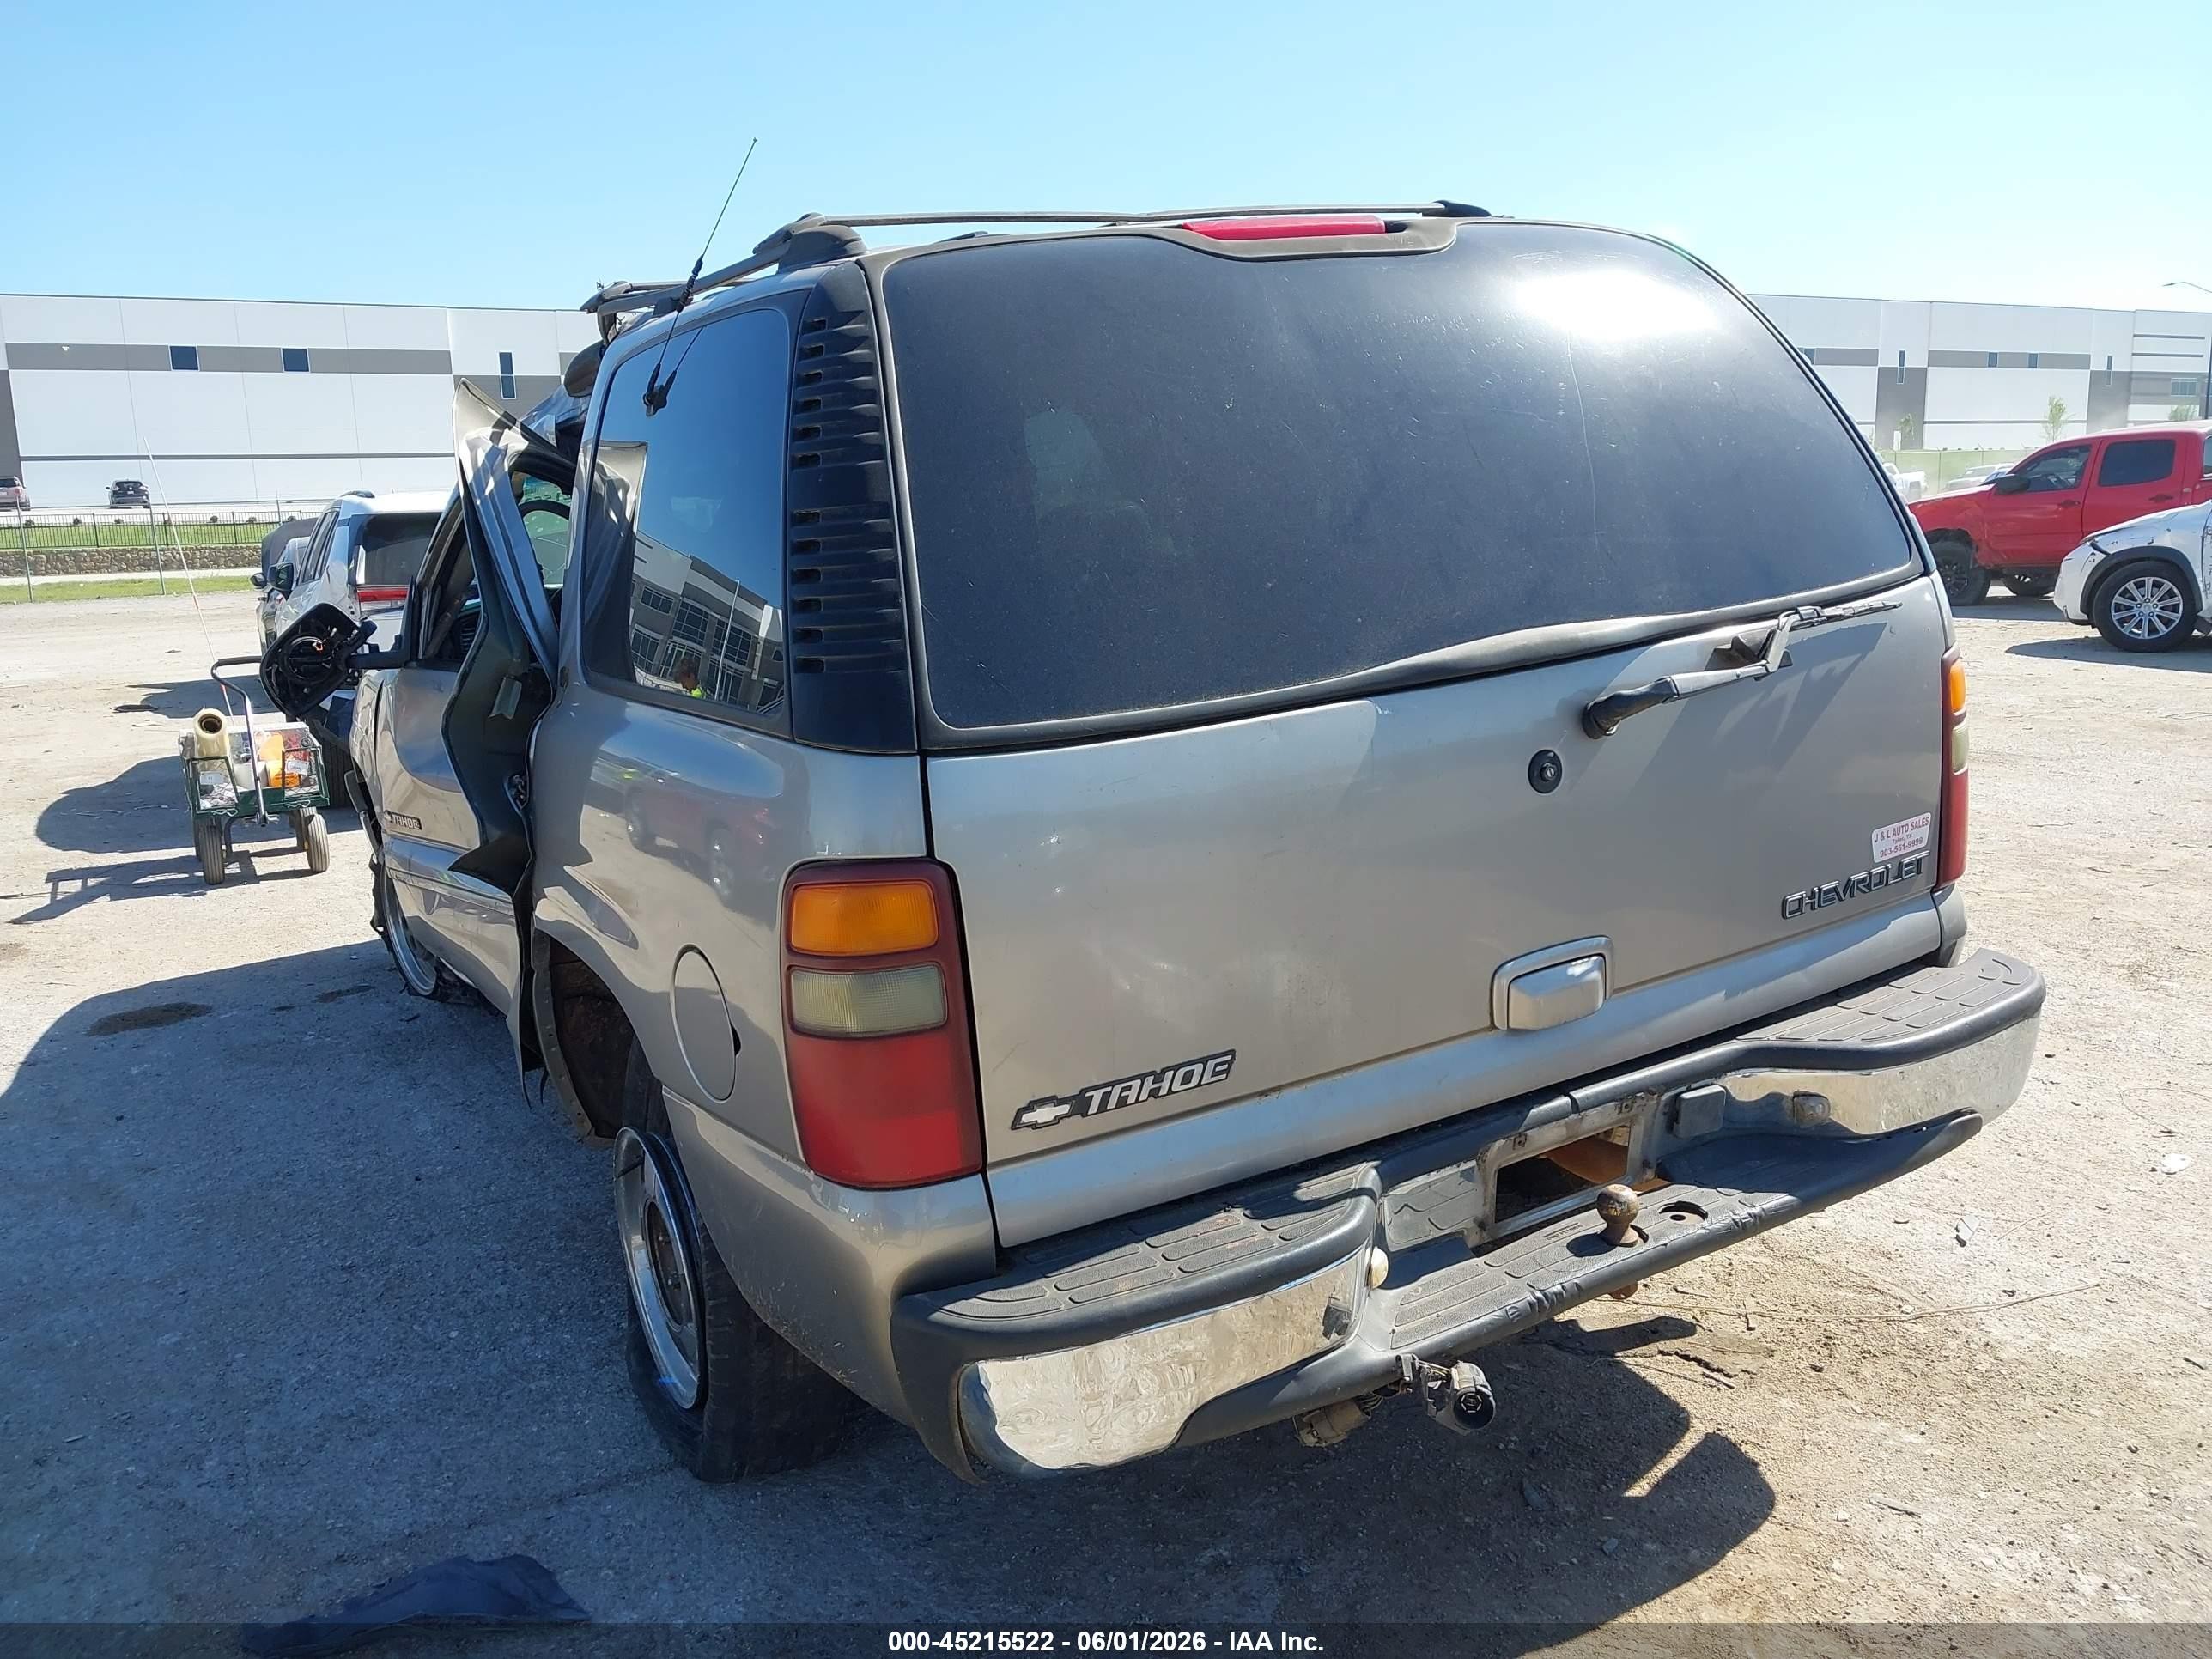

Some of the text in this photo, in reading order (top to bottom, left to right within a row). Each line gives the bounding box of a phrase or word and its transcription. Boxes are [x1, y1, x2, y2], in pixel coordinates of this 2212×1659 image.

[392, 813, 420, 830] TAHOE
[1874, 816, 1929, 843] J & L AUTO SALES
[1782, 850, 1931, 920] CHEVROLET
[1085, 1054, 1233, 1115] TAHOE
